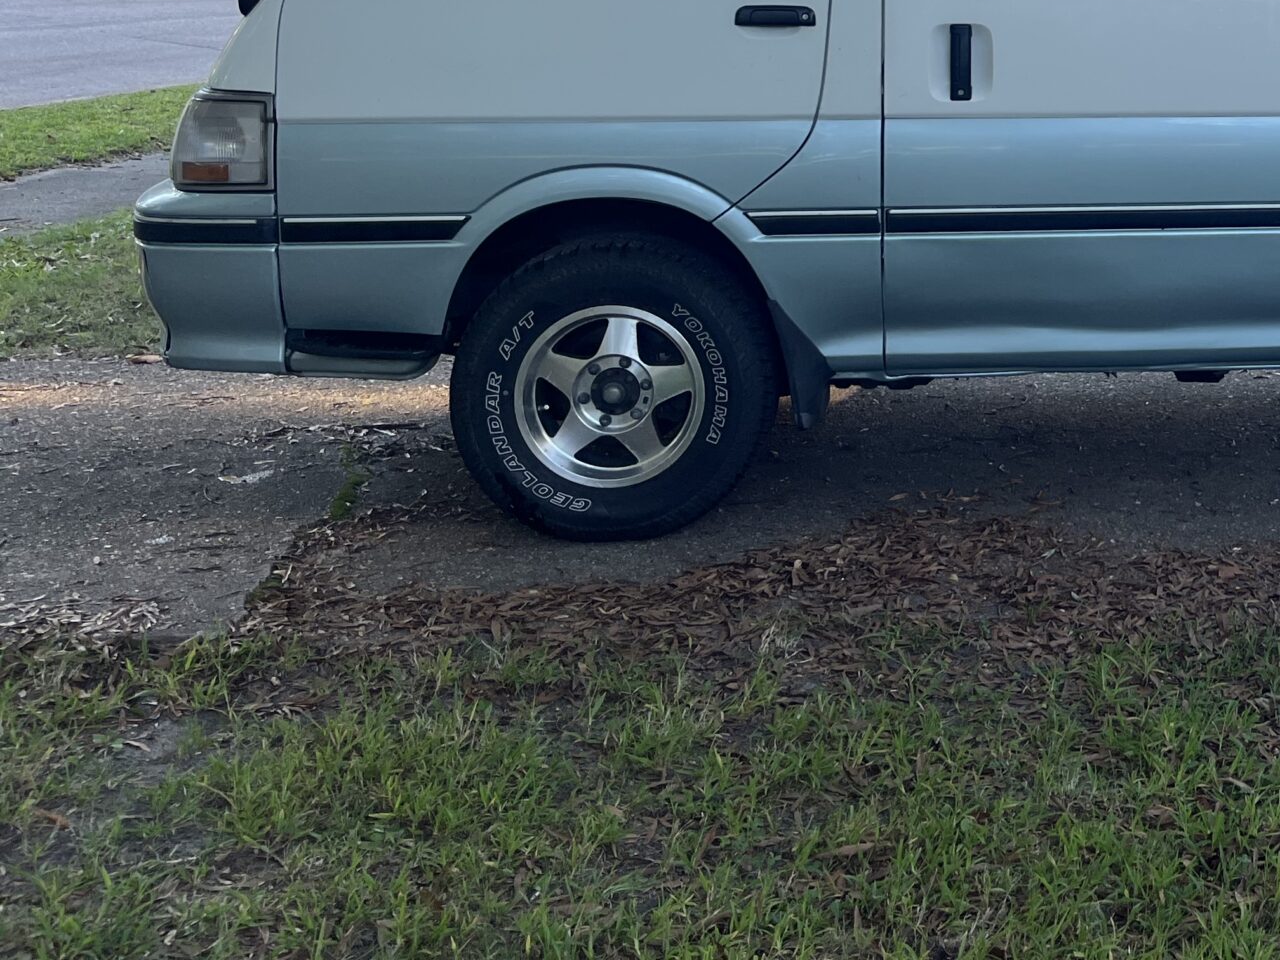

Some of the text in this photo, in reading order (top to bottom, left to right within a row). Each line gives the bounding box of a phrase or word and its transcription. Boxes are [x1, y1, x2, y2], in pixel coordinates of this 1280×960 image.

[485, 310, 592, 513] GEOLANDAR A/T
[671, 303, 729, 445] YOKOHAMA
